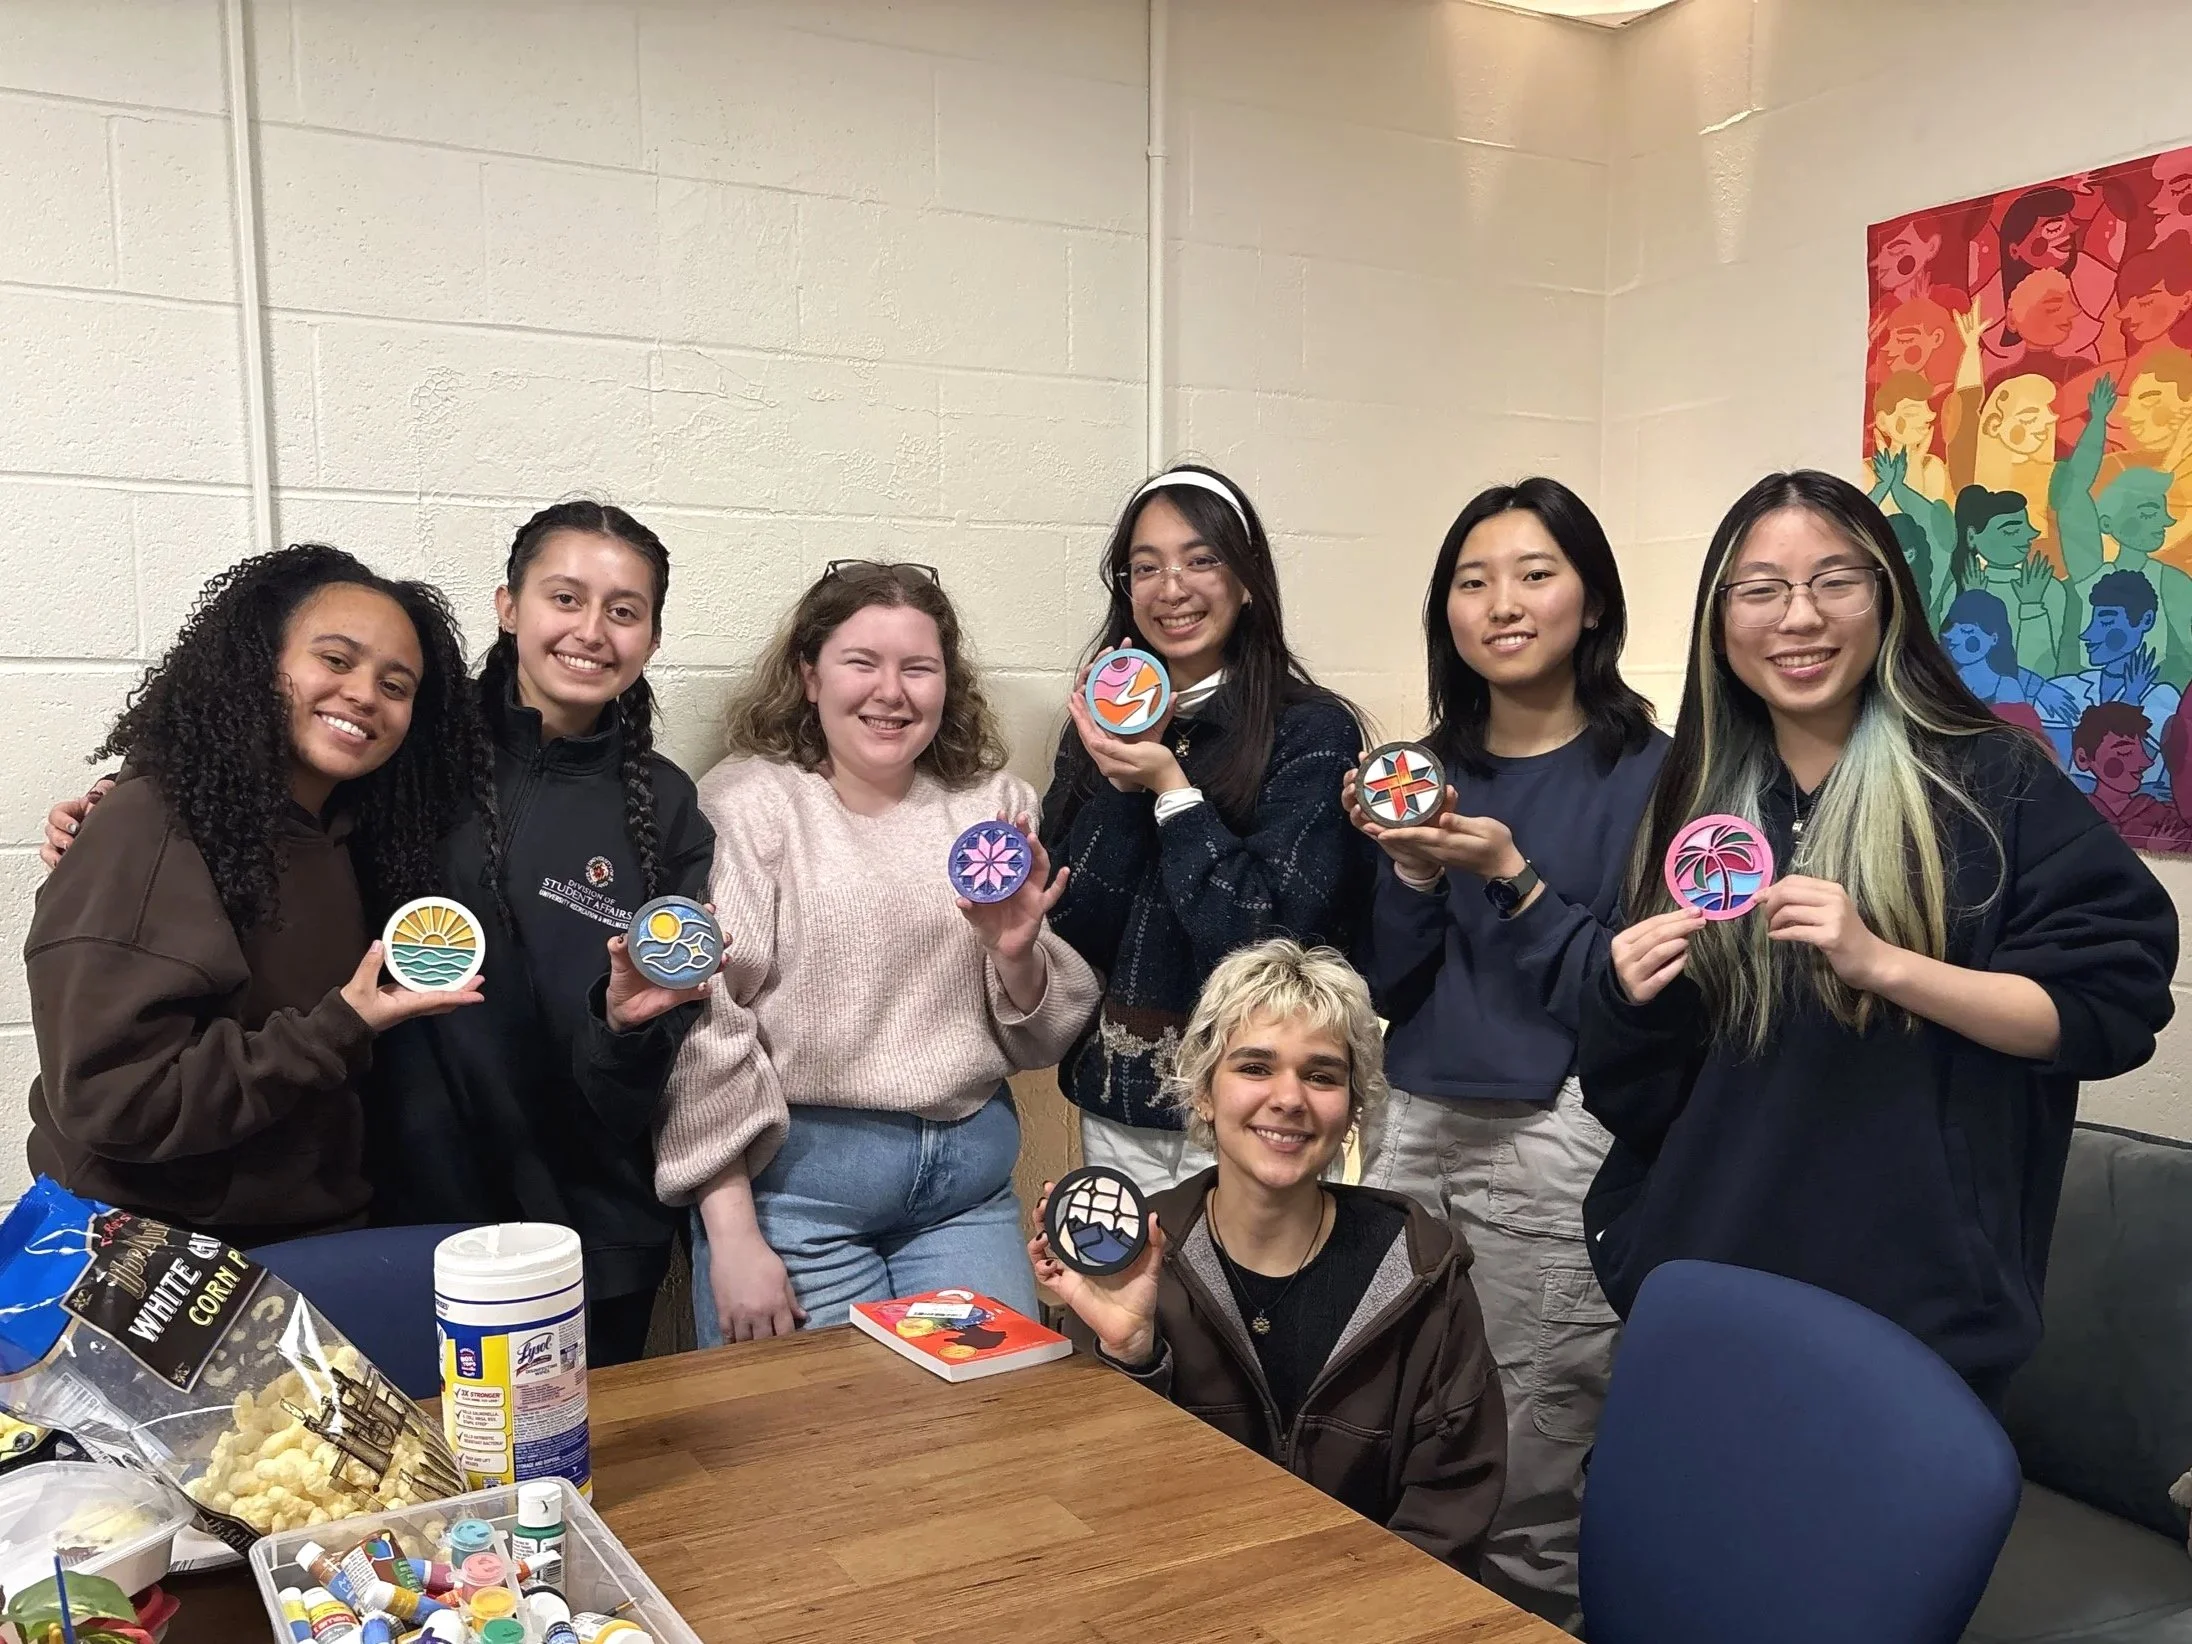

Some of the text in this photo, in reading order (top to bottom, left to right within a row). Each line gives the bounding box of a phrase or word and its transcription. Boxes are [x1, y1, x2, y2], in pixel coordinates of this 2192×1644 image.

[539, 889, 570, 906] UNIVERSITY
[570, 902, 597, 920] RECREATION
[602, 918, 629, 930] WELLNESS
[543, 878, 633, 920] STUDENT AFFAIRS
[568, 880, 616, 905] DIVISION OF
[128, 1257, 202, 1343] WHITE
[188, 1247, 249, 1327] CORN P
[517, 1335, 552, 1364] Lysol
